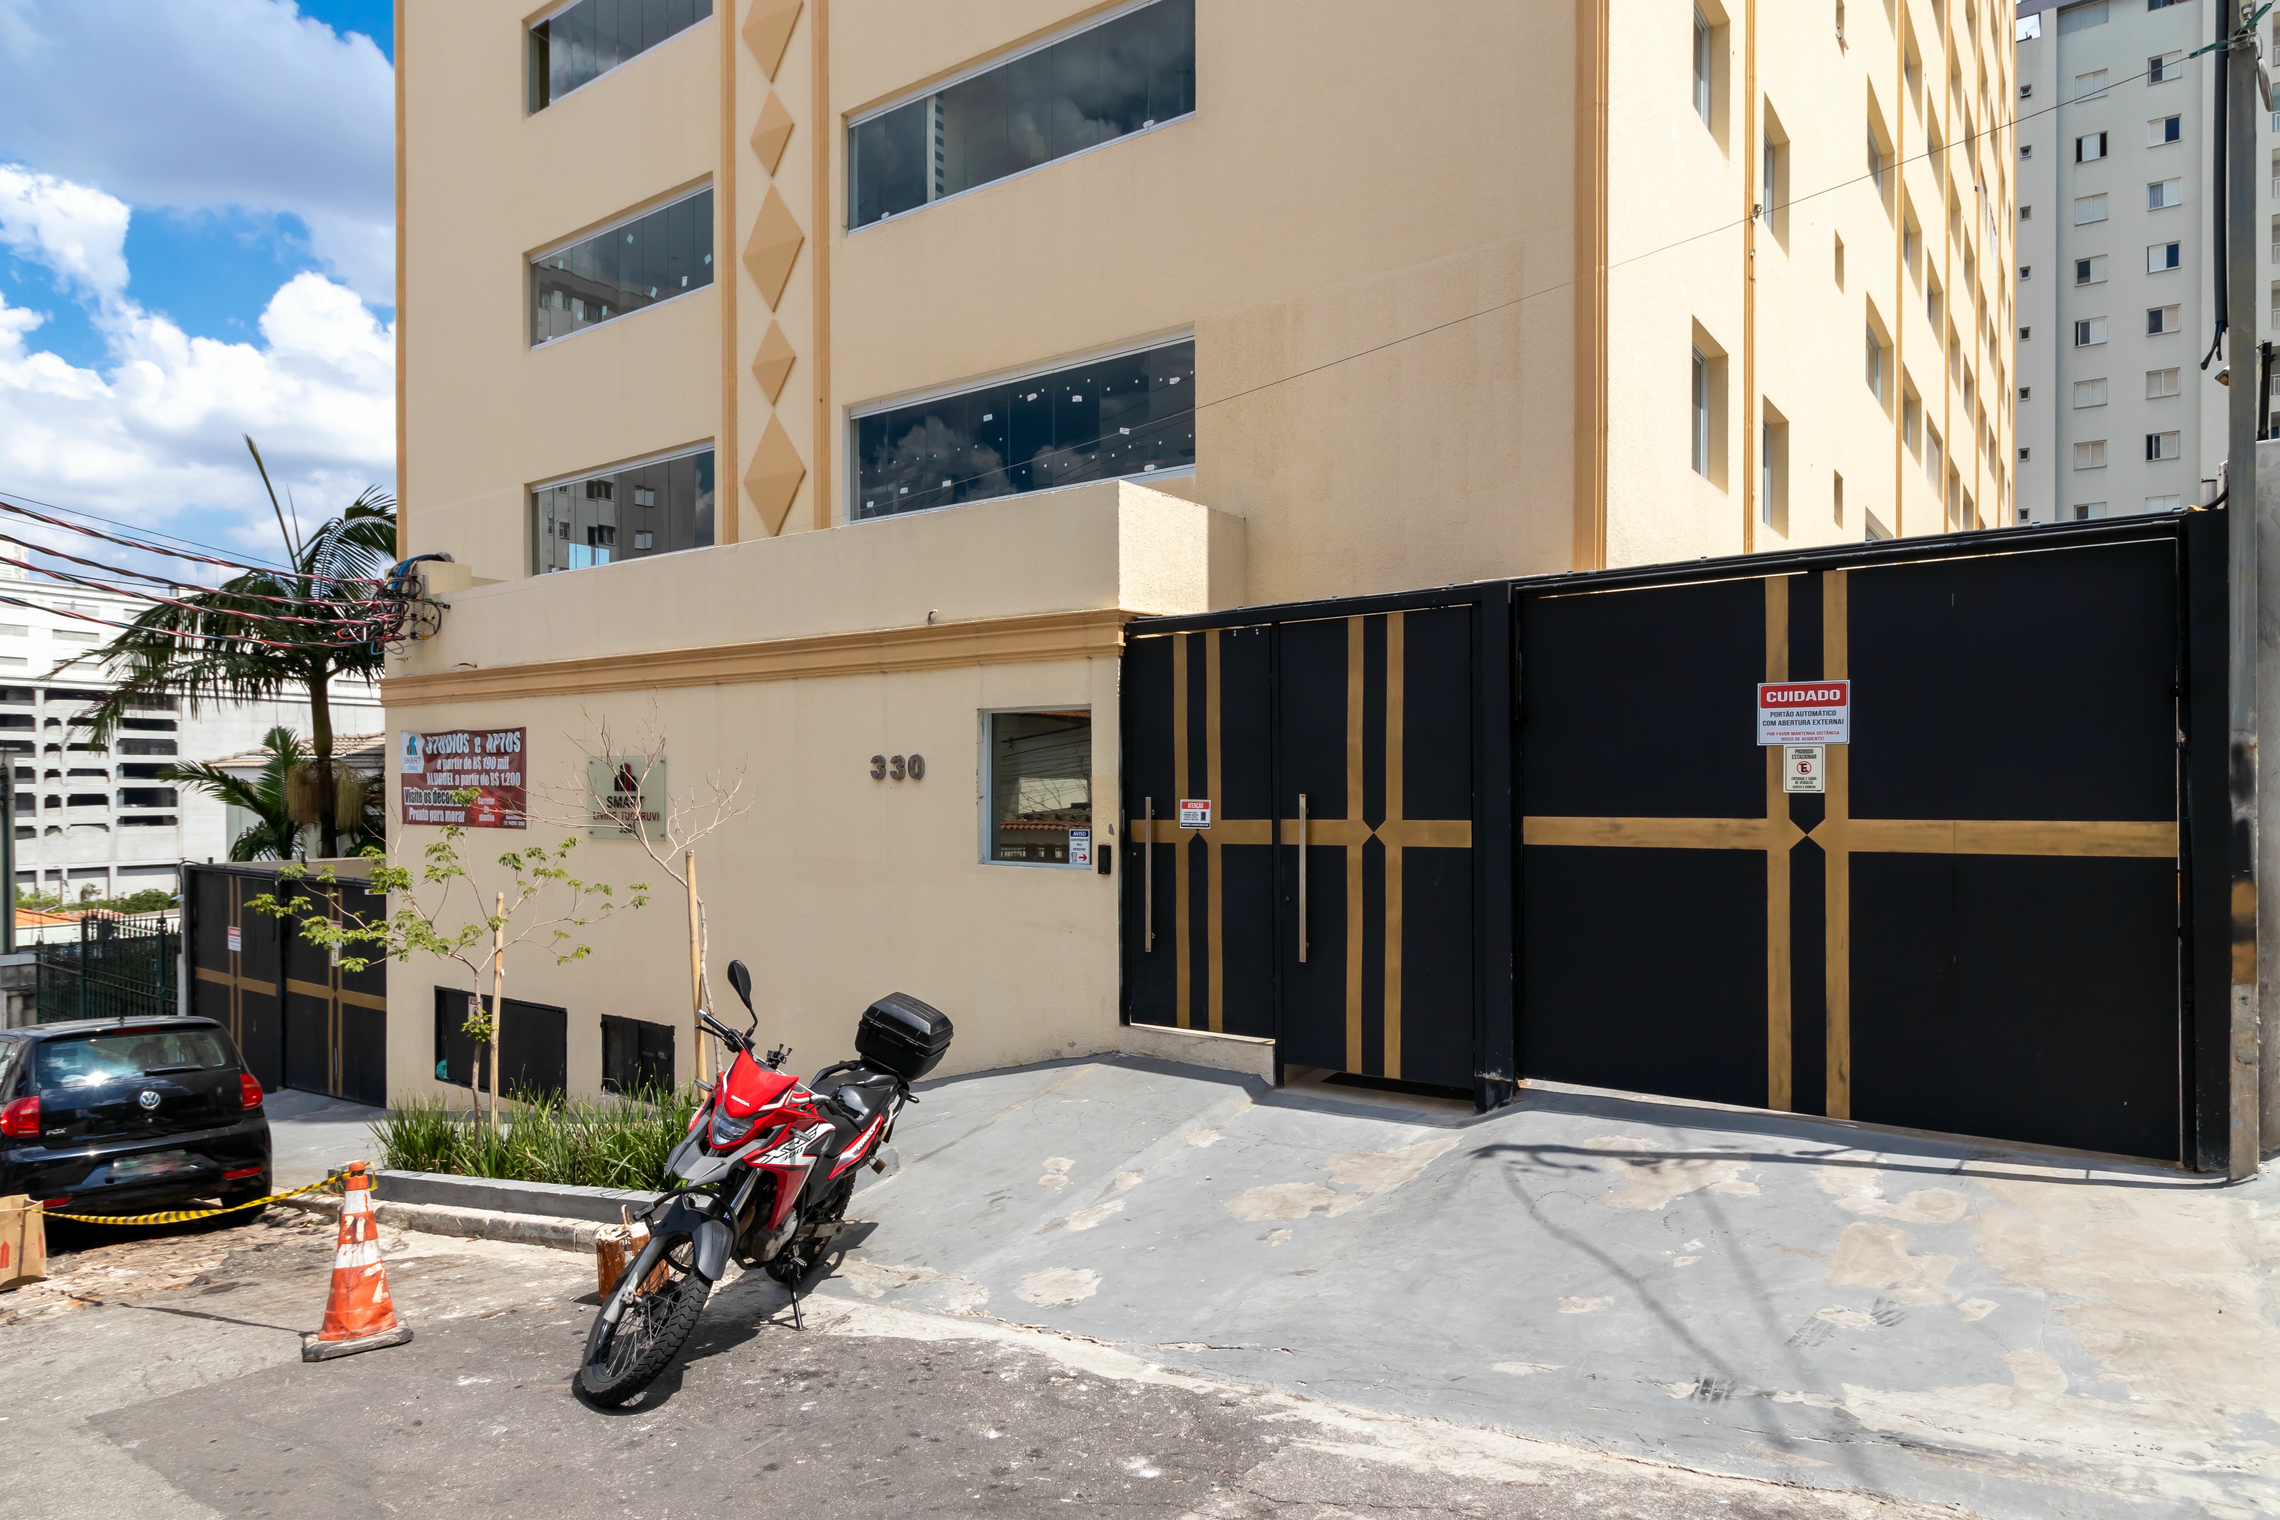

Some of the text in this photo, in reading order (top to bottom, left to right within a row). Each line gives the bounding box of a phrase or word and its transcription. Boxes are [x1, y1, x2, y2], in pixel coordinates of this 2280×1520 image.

[1766, 689, 1841, 703] CUIDADO
[1770, 709, 1837, 718] PORTÃO AUTOMÁTICO
[1812, 718, 1844, 726] EXTERNA!
[425, 732, 470, 755] STUDIOS
[486, 731, 521, 754] APTOS
[437, 756, 509, 771] a partir de R$ 190 mil
[870, 754, 926, 780] 330
[426, 772, 454, 786] ALUGUEL
[455, 774, 460, 786] a
[460, 773, 479, 787] partir
[480, 773, 489, 786] de
[490, 771, 499, 787] R$
[404, 788, 423, 804] Visite
[423, 790, 431, 804] os
[1187, 801, 1204, 809] ATENÇÃO
[409, 807, 465, 823] Pronto para morar
[730, 1094, 750, 1107] HONDA
[46, 1127, 67, 1136] FOX
